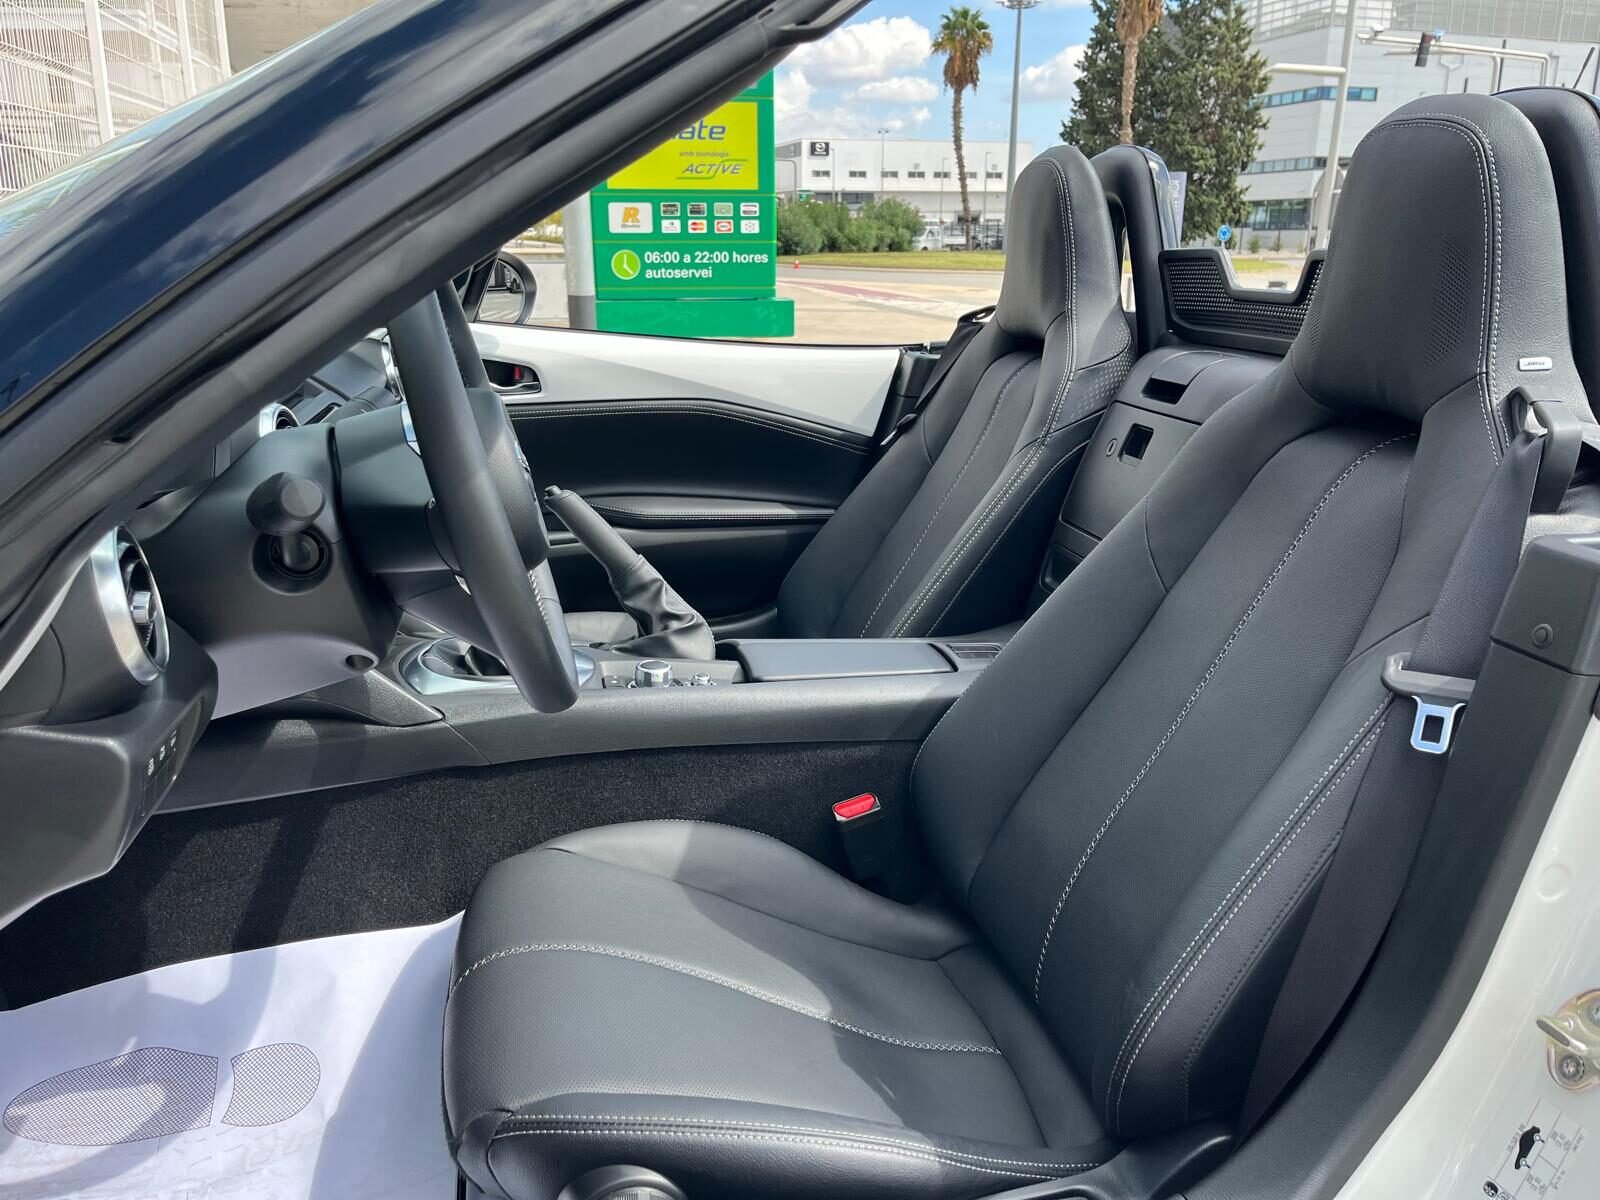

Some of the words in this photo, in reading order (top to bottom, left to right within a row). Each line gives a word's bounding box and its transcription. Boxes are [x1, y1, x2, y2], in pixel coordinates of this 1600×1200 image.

[674, 119, 726, 140] ate
[682, 163, 744, 175] ACTIVE
[644, 251, 680, 264] 06:00
[683, 253, 691, 264] a
[694, 251, 729, 264] 22:00
[732, 250, 769, 264] hores
[645, 266, 713, 279] autoservei
